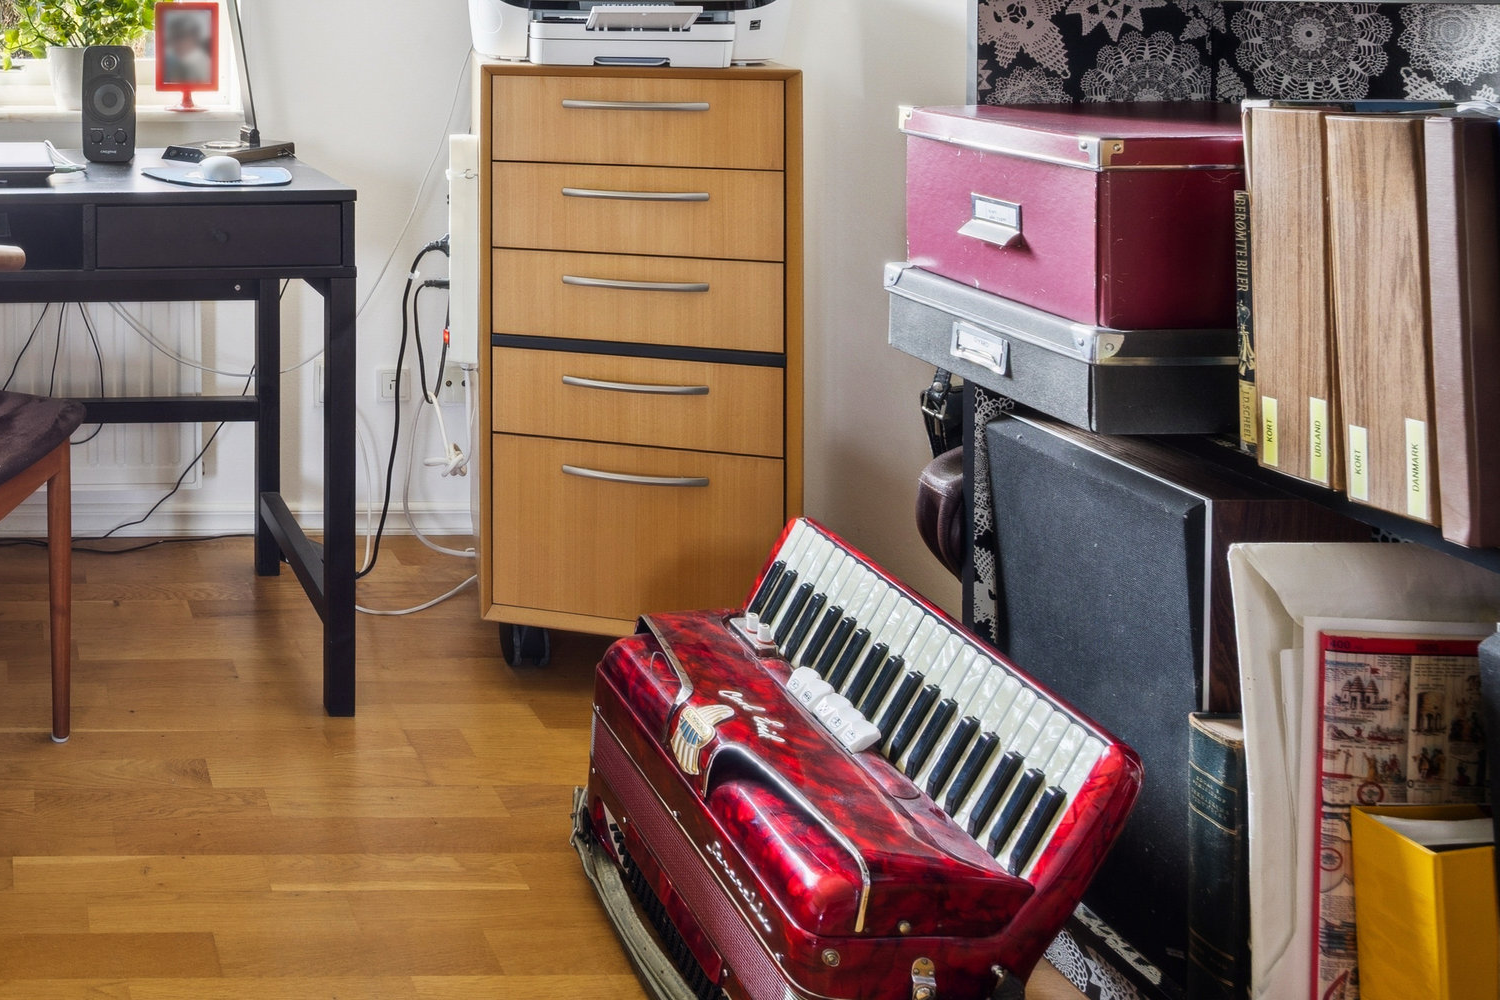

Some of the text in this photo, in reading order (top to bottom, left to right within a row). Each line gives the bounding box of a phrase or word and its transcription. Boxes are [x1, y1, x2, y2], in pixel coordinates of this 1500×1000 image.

[1235, 199, 1249, 292] BERØMTE BILER
[1354, 449, 1362, 475] KORT
